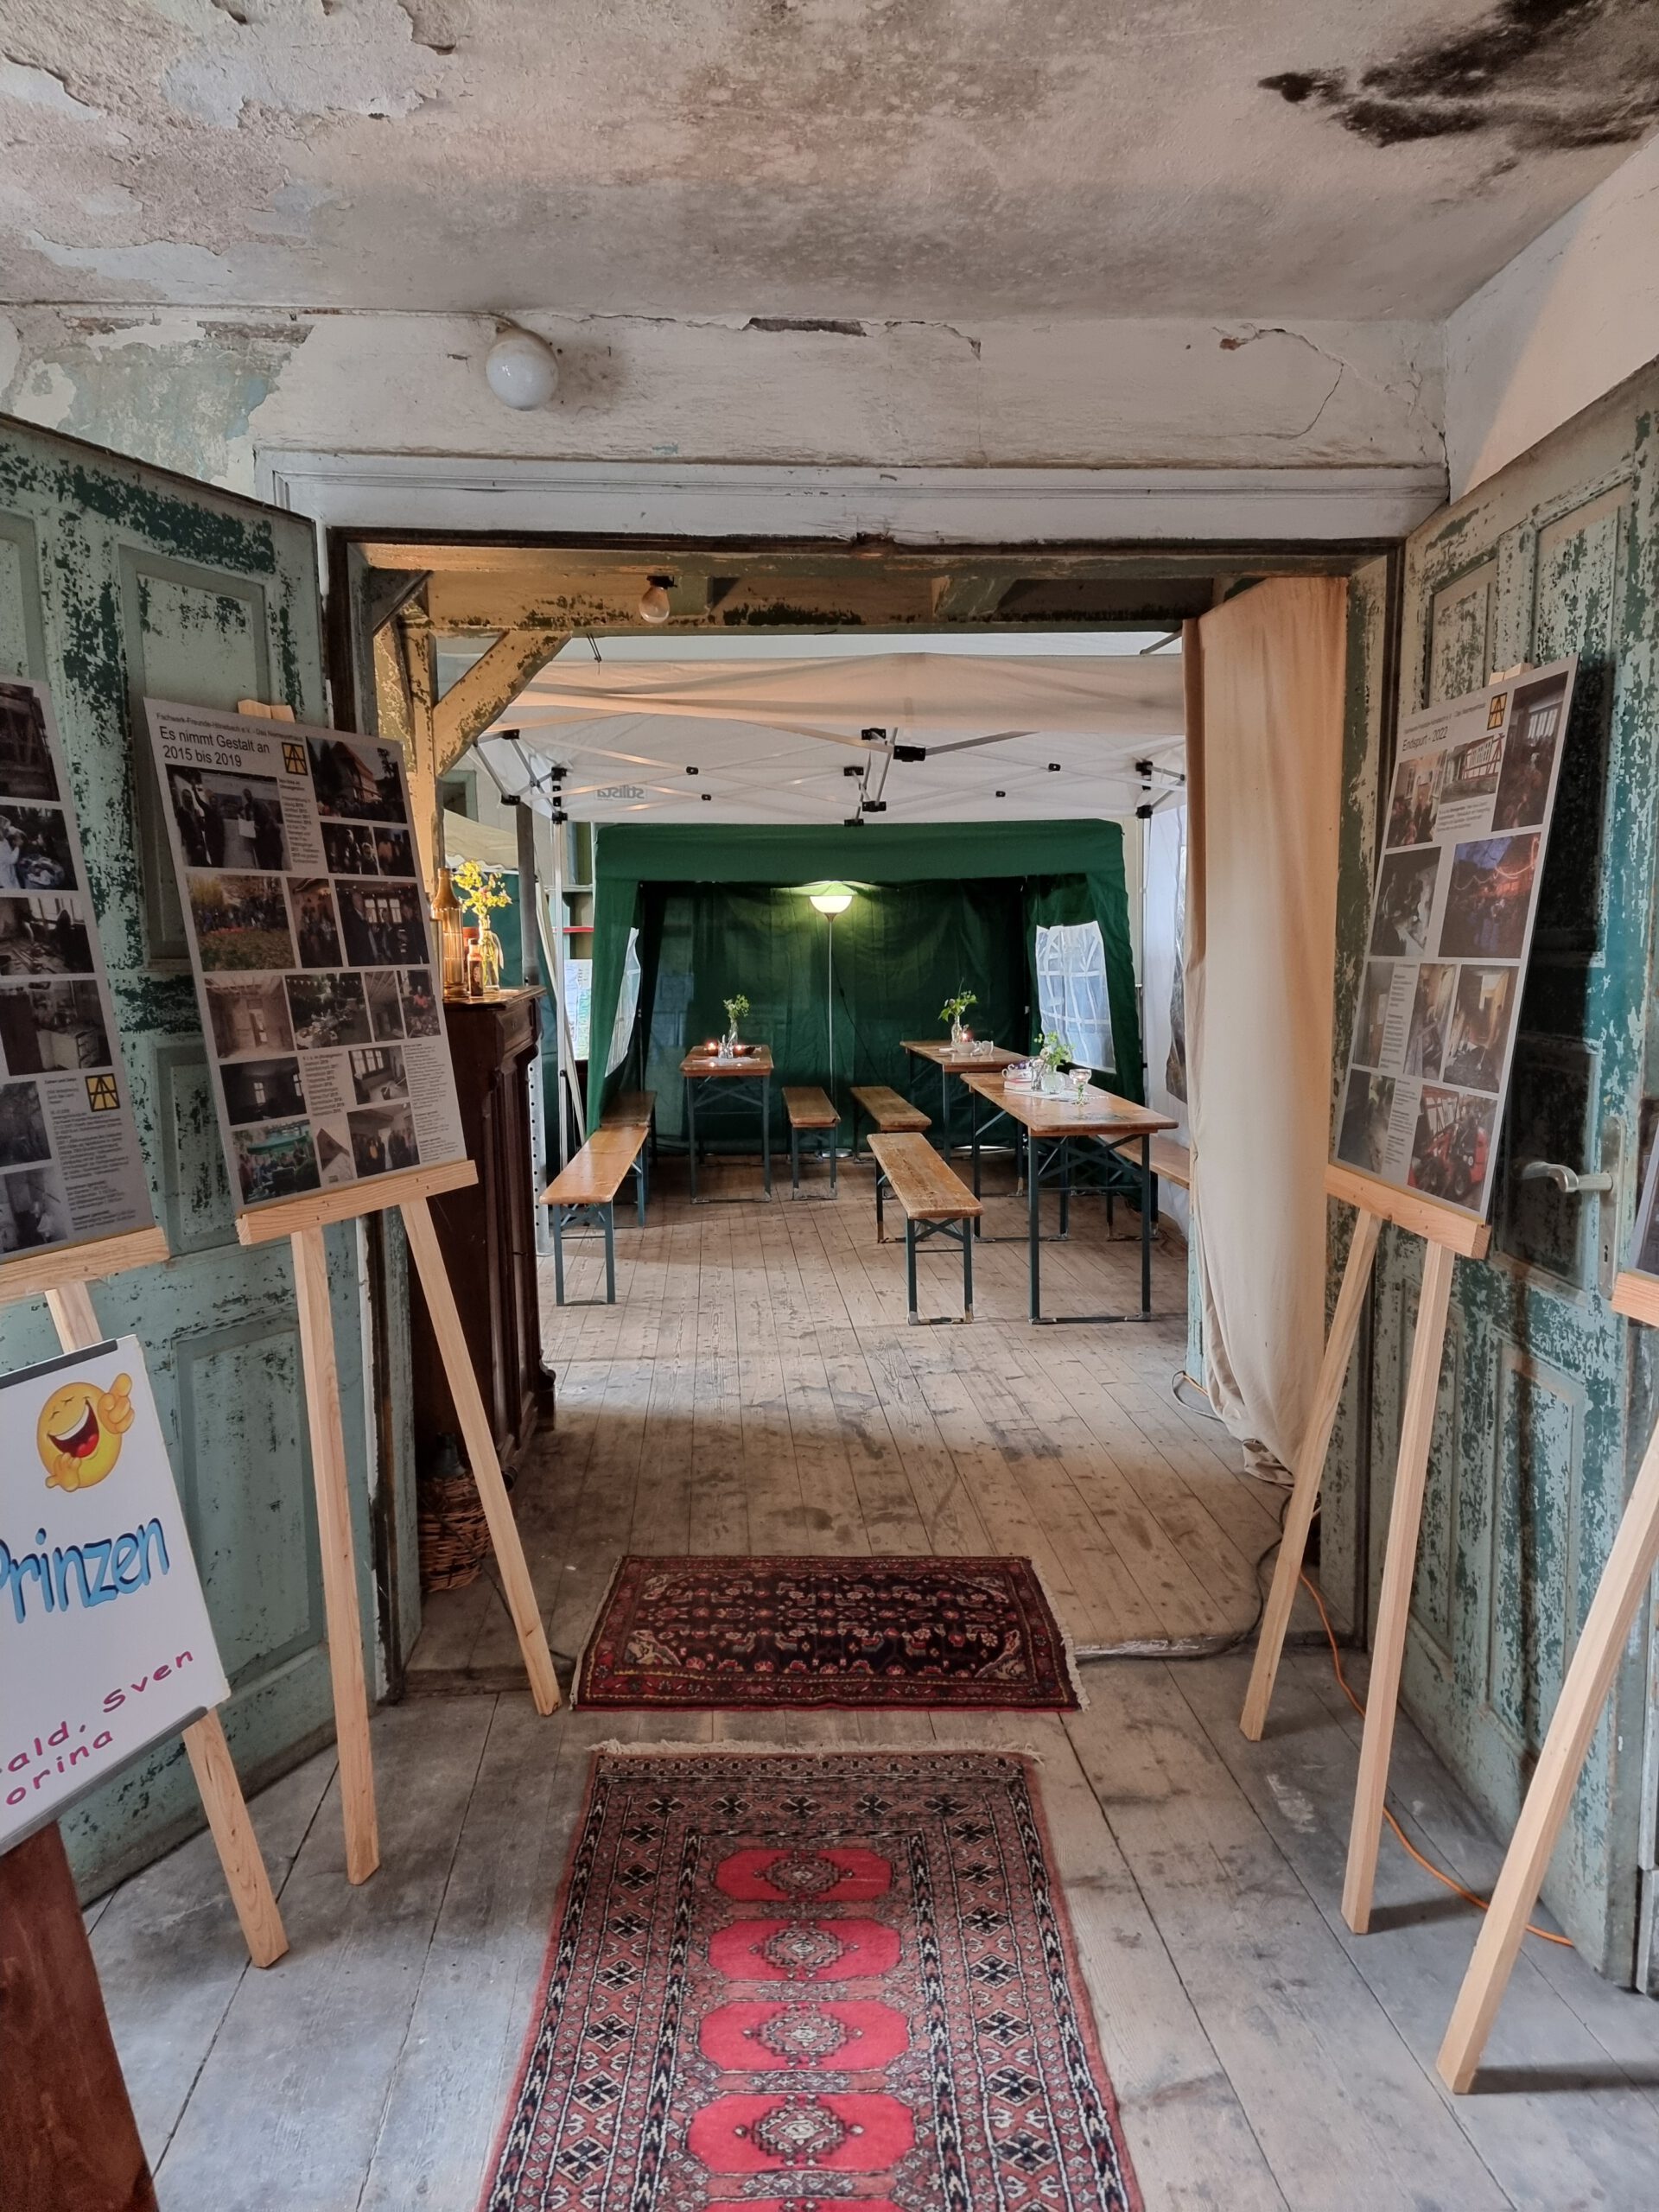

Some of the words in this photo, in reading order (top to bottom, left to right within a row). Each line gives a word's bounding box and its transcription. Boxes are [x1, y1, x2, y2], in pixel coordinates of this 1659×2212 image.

[159, 726, 175, 741] Es
[179, 730, 213, 747] nimmt
[216, 734, 255, 752] Gestalt
[257, 743, 270, 753] an
[1432, 726, 1448, 742] 2022
[162, 745, 193, 760] 2015
[195, 750, 213, 764] bis
[215, 752, 242, 767] 2019
[103, 1650, 194, 1713] Sven
